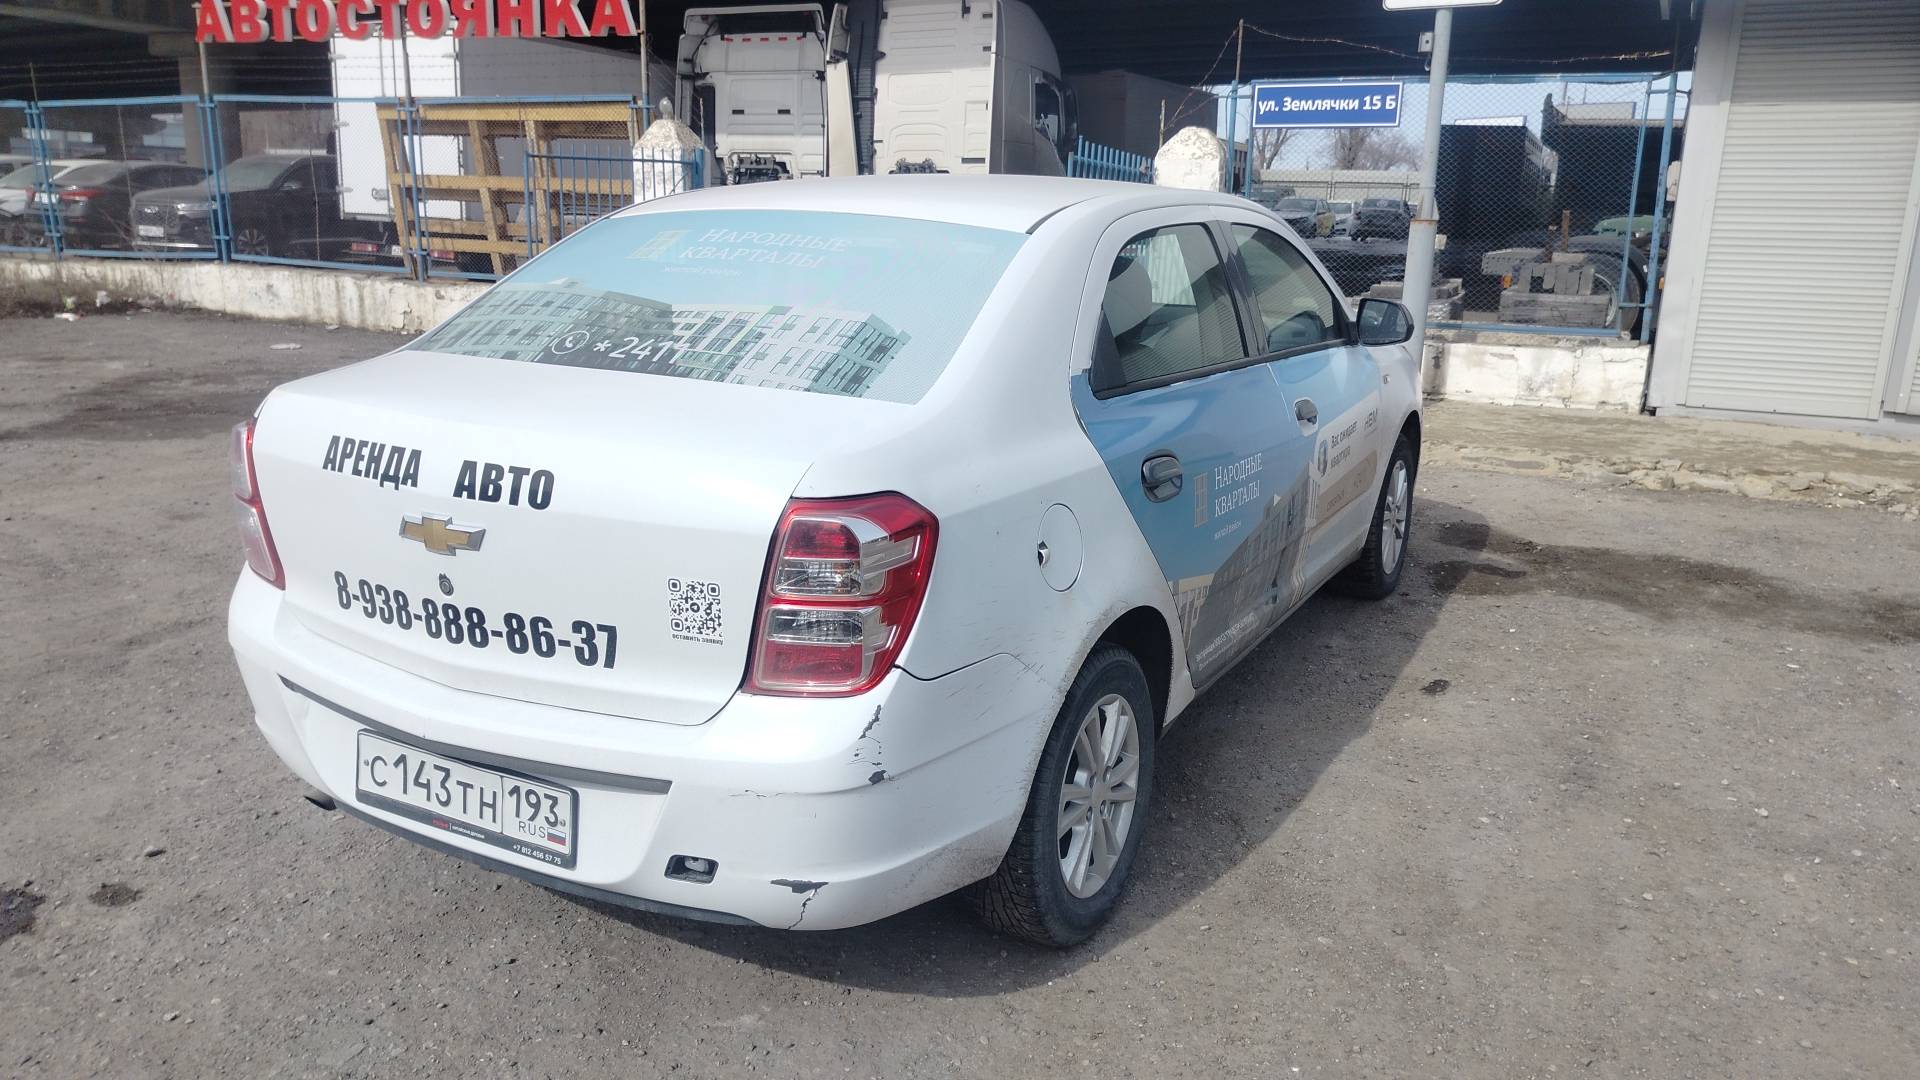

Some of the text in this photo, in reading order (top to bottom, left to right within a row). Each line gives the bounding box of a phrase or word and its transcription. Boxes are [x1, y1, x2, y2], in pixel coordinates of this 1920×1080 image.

[196, 0, 637, 42] АВТОСТОЯНКА
[1258, 95, 1396, 115] ул. Землячки 15 Б
[678, 246, 827, 269] КВАРТАЛЫ
[697, 228, 852, 252] НАРОДНЫЕ
[322, 435, 555, 511] АРЕНДА АВТО
[1214, 452, 1263, 490] НАРОДНЫЕ
[1214, 479, 1260, 518] КВАРТАЛЫ
[334, 570, 618, 670] 8-938-888-86-37
[507, 784, 560, 828] 193
[518, 820, 547, 839] RUS
